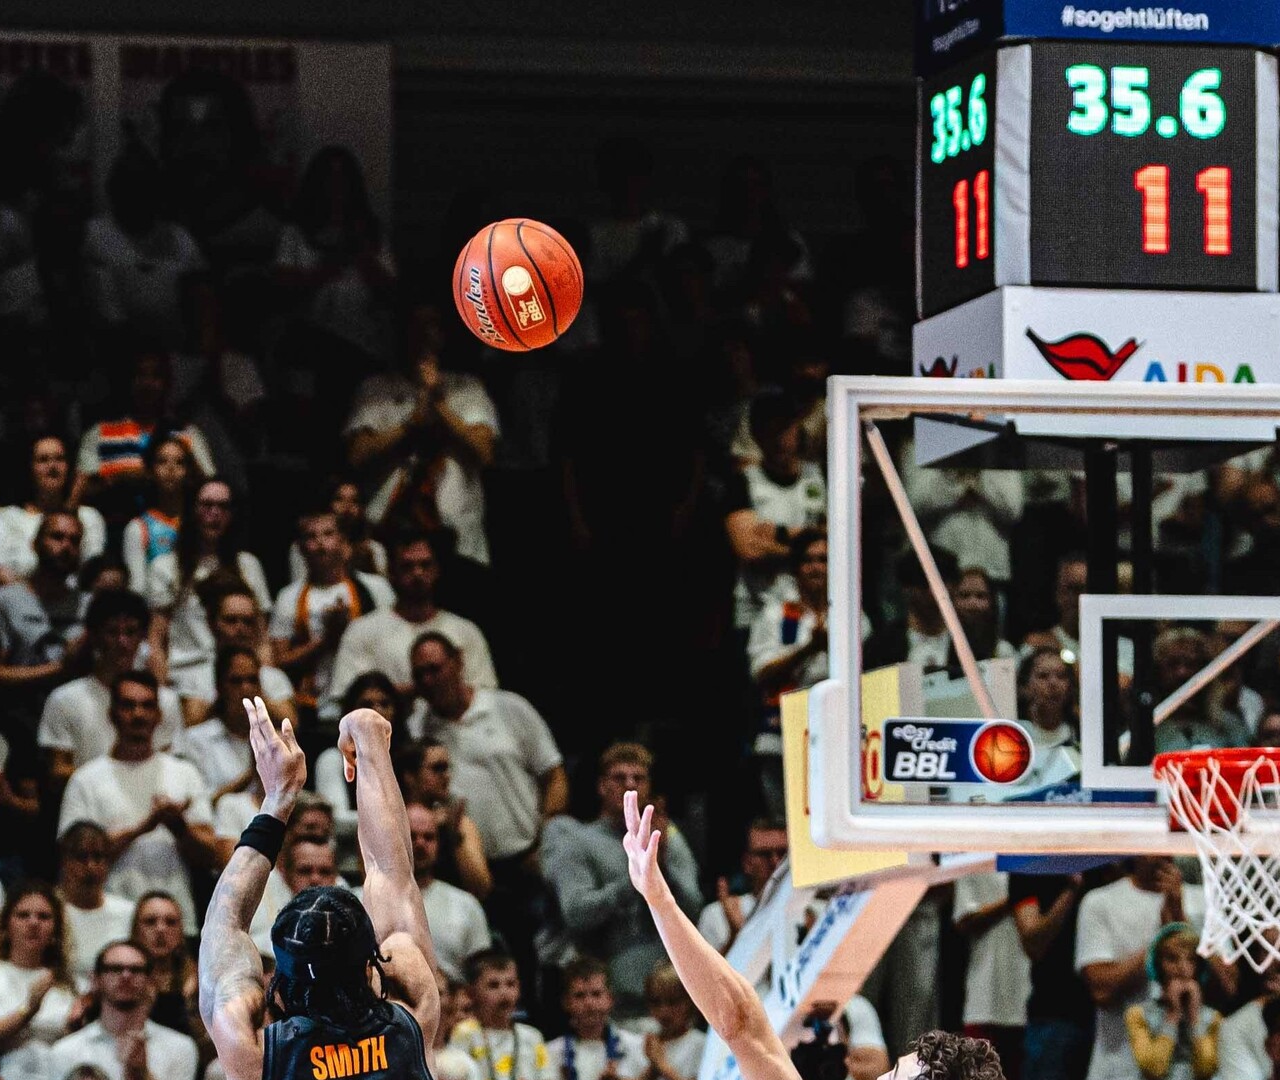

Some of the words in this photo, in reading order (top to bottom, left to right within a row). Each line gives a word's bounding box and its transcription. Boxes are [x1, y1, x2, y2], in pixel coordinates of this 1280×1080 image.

[1061, 5, 1209, 34] #sogehtlüften
[930, 72, 987, 164] 35.6
[1065, 63, 1227, 140] 35.6
[952, 169, 990, 268] 11
[1134, 163, 1233, 256] 11
[892, 751, 957, 780] BBL
[911, 736, 959, 752] Credit
